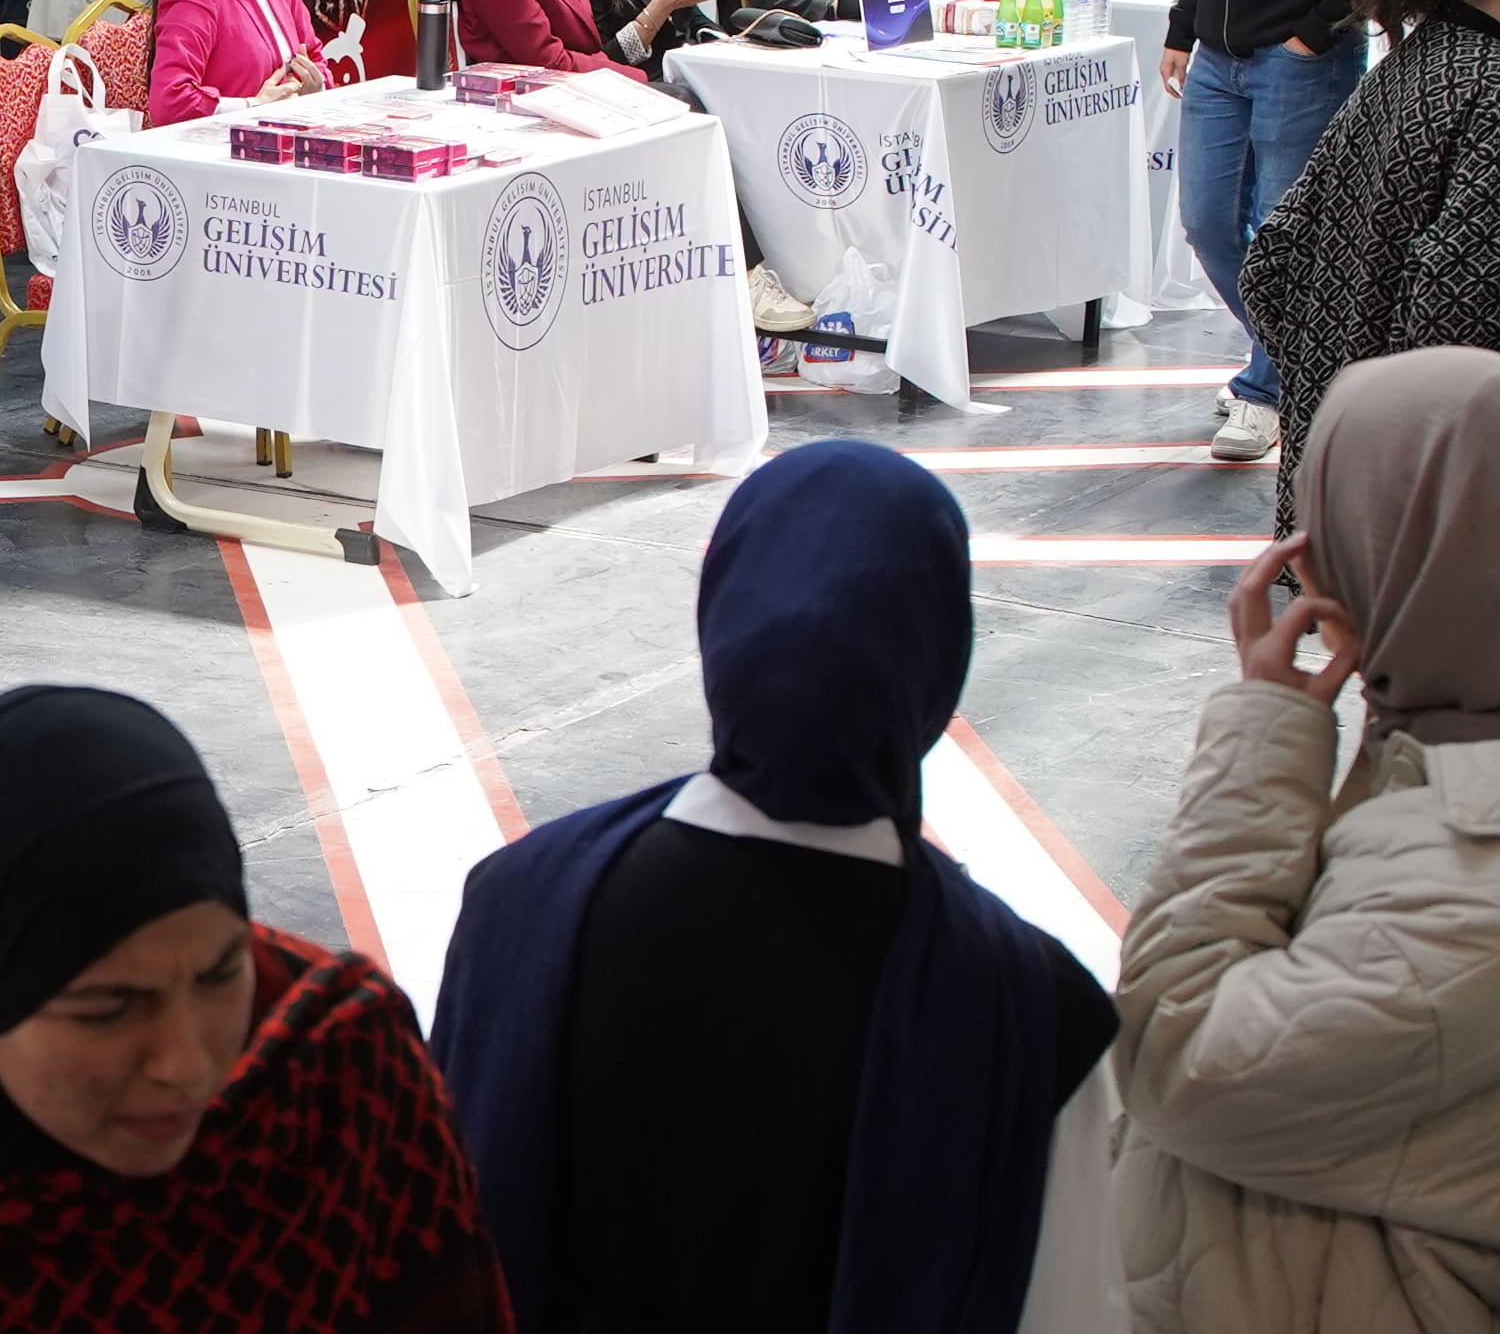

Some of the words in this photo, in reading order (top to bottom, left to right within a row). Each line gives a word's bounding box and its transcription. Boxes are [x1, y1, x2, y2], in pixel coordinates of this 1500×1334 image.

[1044, 59, 1108, 97] GELİŞİM
[204, 191, 281, 219] İSTANBUL
[583, 179, 648, 212] İSTANBUL
[203, 216, 328, 257] GELİŞİM
[582, 201, 687, 259] GELİŞİM
[202, 244, 400, 301] ÜNİVERSİTESİ
